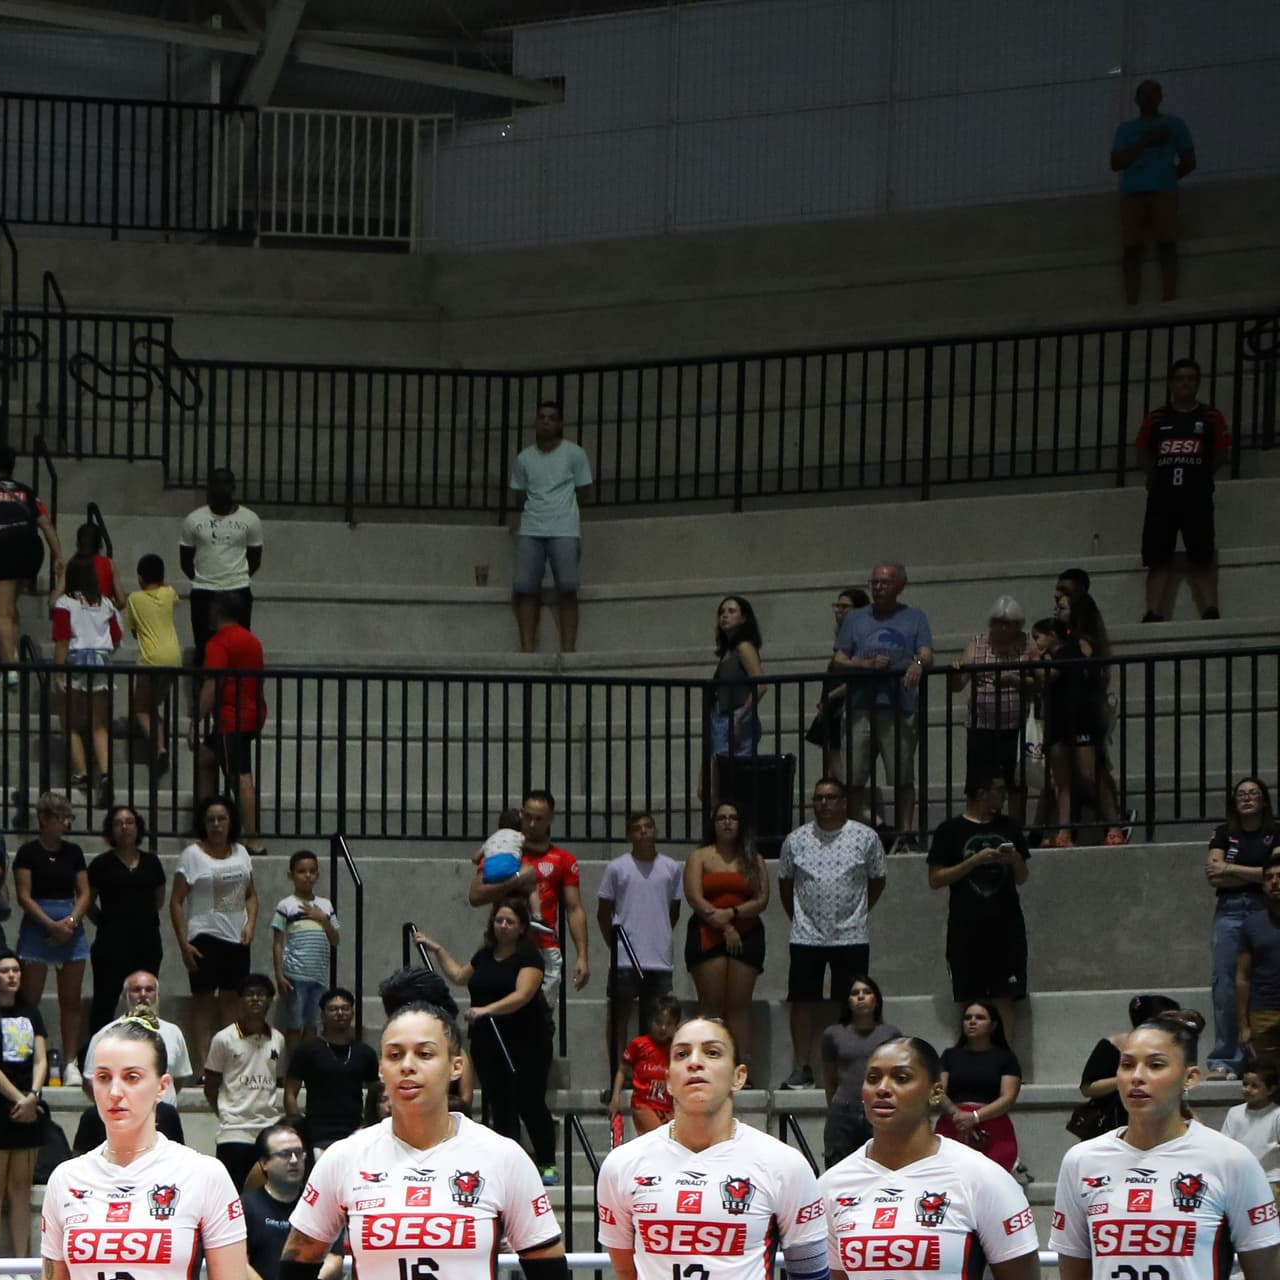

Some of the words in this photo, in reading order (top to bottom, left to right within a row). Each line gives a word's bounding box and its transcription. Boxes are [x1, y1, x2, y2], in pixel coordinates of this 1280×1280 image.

[1160, 440, 1200, 455] SESI
[1172, 467, 1184, 486] 8
[239, 1074, 273, 1086] QATAR
[357, 1200, 383, 1209] FIESP
[452, 1194, 478, 1203] SESI
[724, 1201, 749, 1210] SESI
[1174, 1199, 1200, 1207] SESI
[917, 1215, 942, 1223] SESI
[369, 1218, 466, 1247] SESI
[648, 1225, 735, 1252] SESI
[1098, 1224, 1188, 1252] SESI
[74, 1233, 161, 1261] SESI
[845, 1239, 928, 1267] SESI
